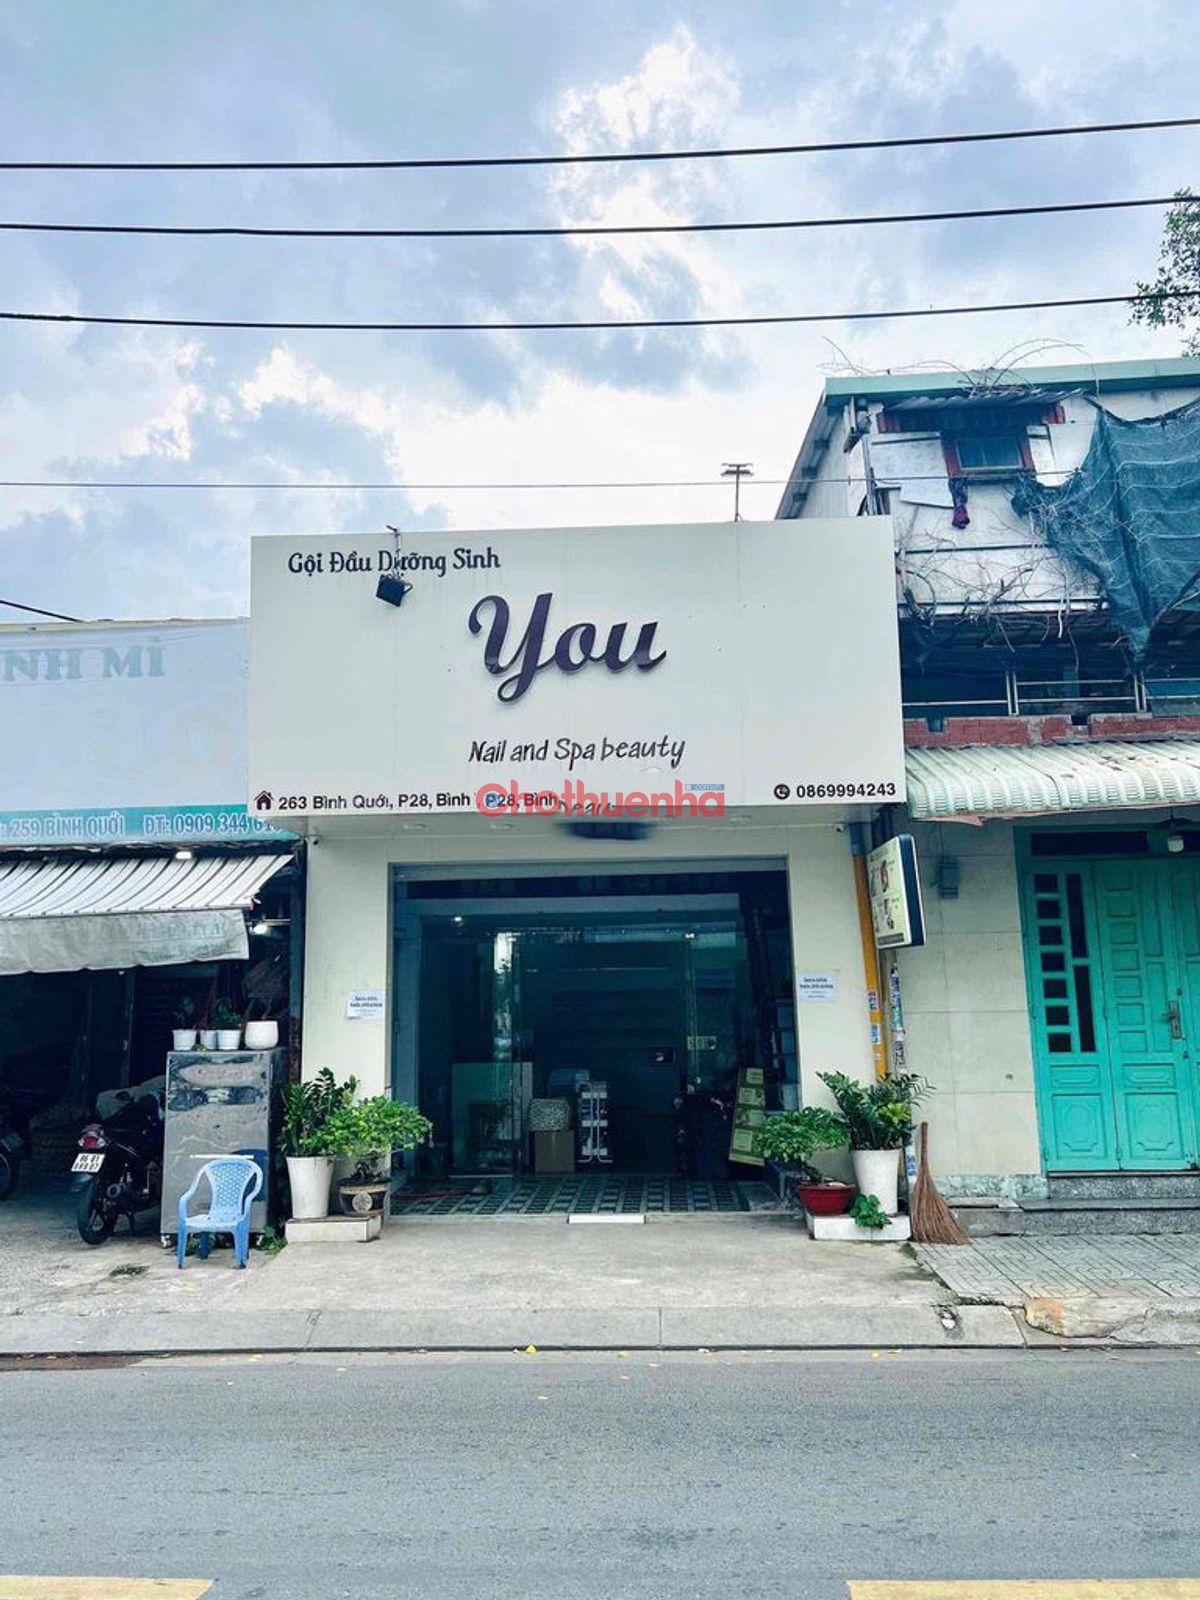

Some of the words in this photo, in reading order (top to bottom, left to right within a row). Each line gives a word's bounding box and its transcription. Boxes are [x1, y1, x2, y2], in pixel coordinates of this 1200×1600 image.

[288, 552, 323, 577] Gội
[329, 550, 373, 574] Đầu
[378, 550, 448, 578] Dưỡng
[452, 547, 501, 570] Sinh
[468, 592, 667, 702] You
[468, 740, 507, 763] Nail
[510, 739, 549, 762] and
[554, 737, 597, 771] Spa
[600, 735, 686, 769] beauty
[278, 796, 308, 811] 263
[312, 794, 348, 810] Bình
[398, 793, 433, 810] P28,
[436, 792, 471, 808] Bình
[796, 783, 896, 798] 0869994243
[11, 818, 41, 838] 259
[45, 812, 84, 838] BÌNH
[174, 814, 214, 834] 0909
[219, 813, 249, 833] 344
